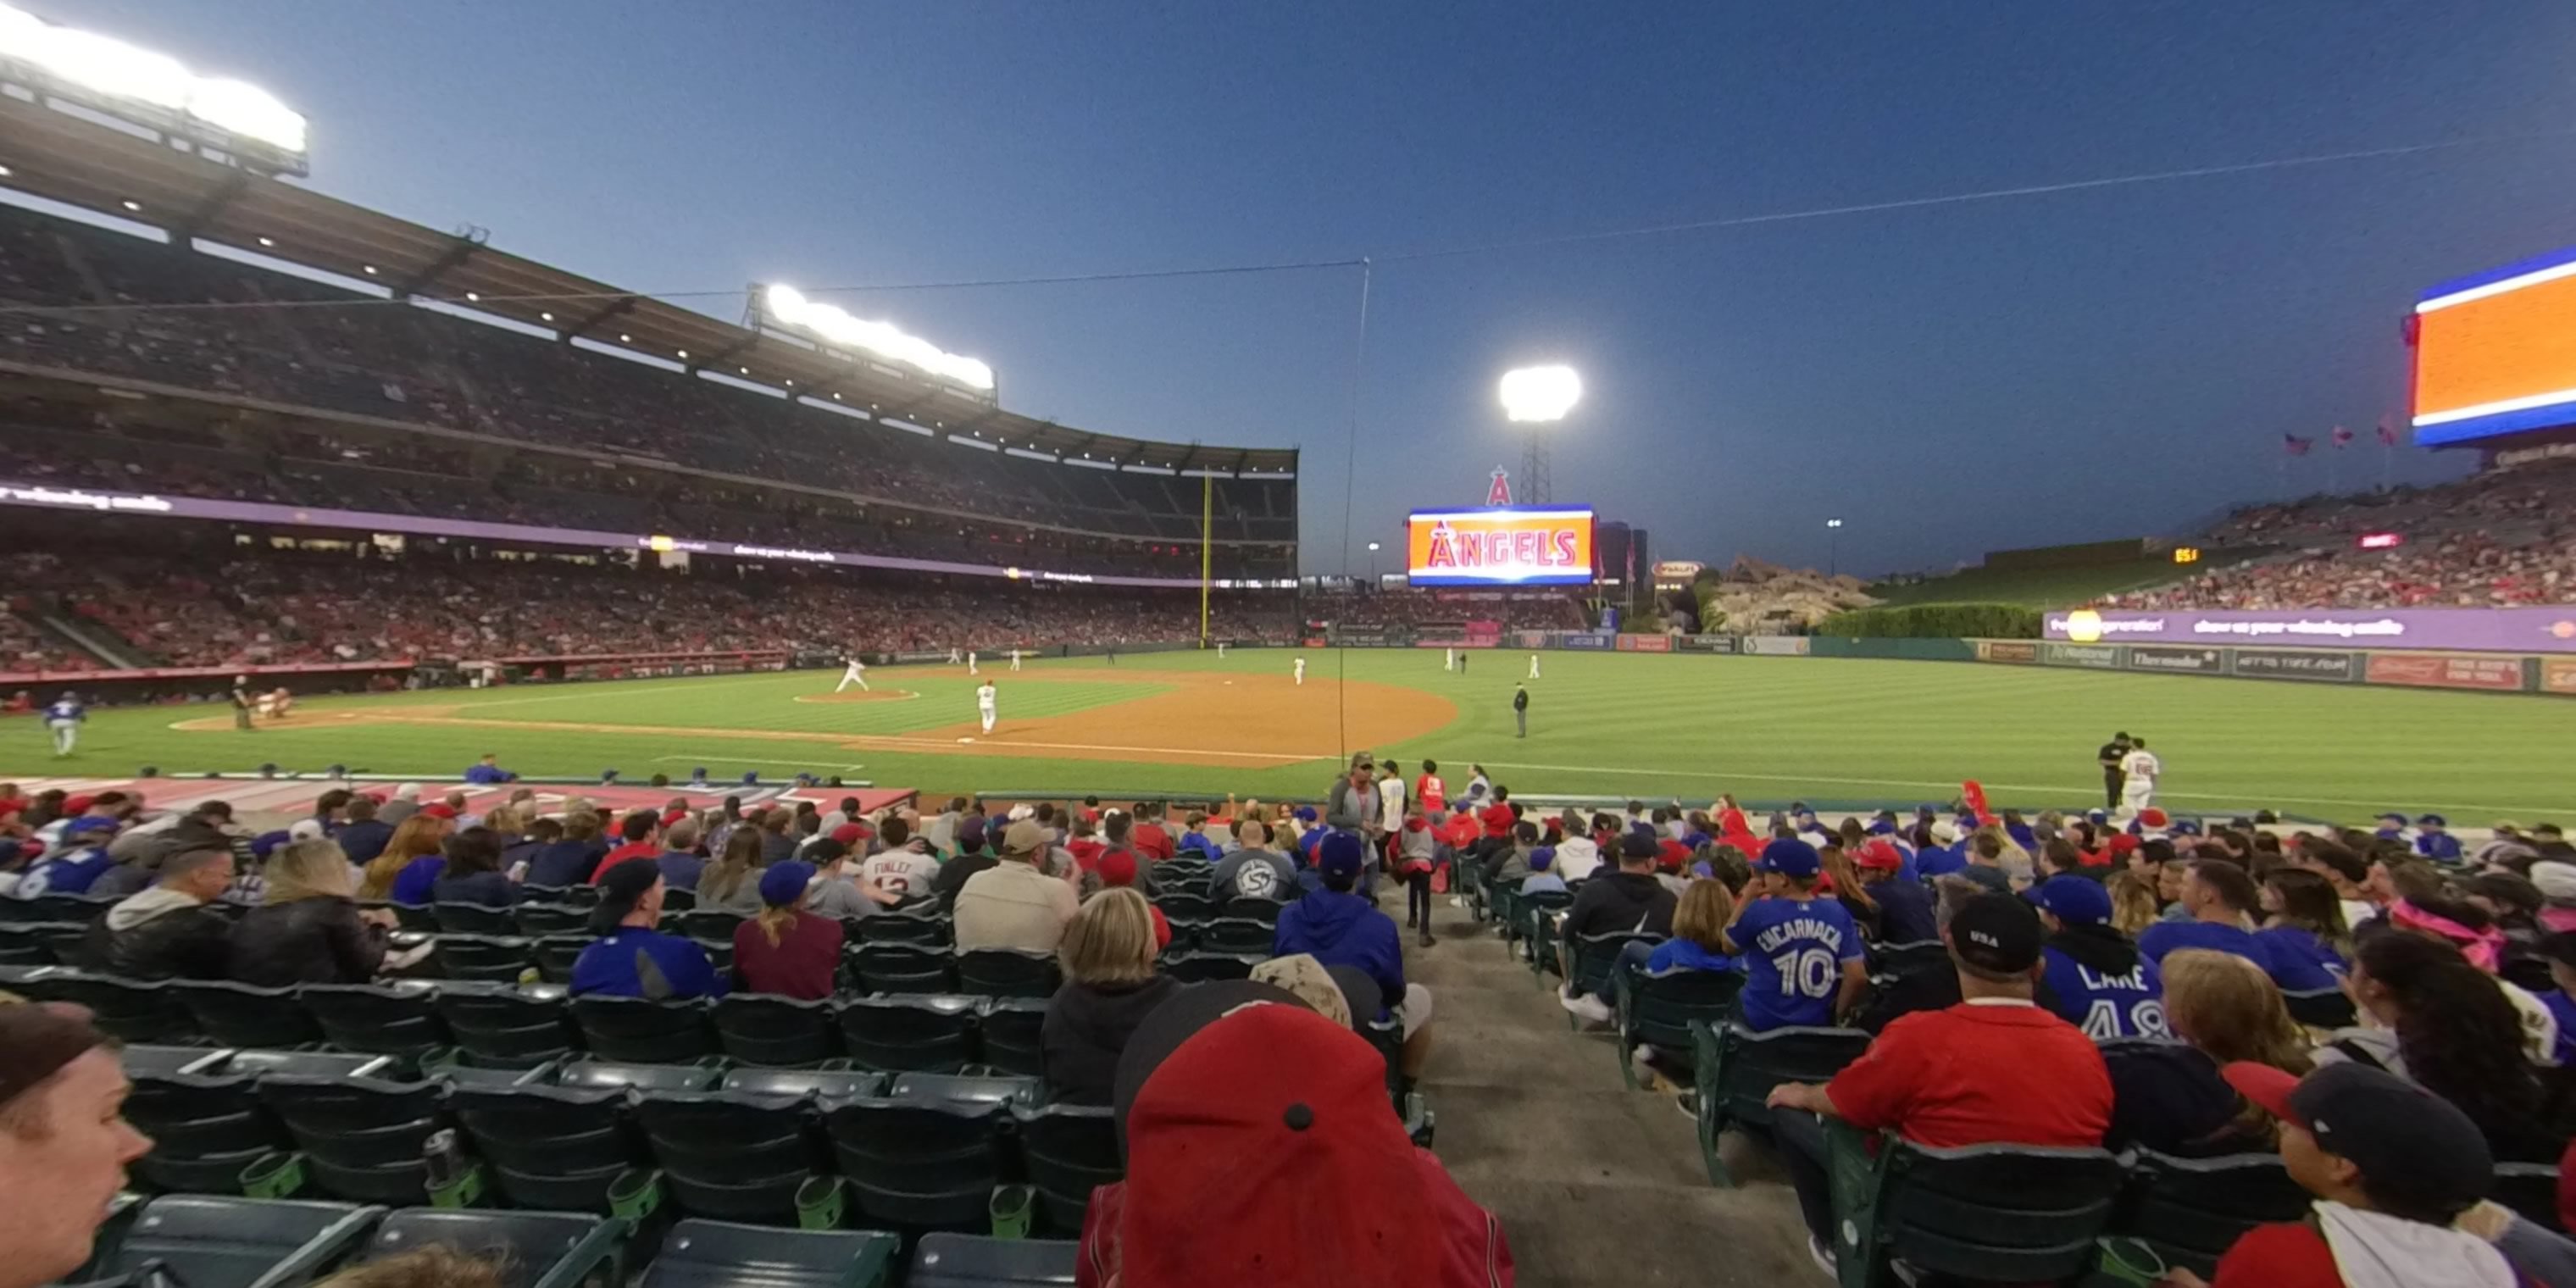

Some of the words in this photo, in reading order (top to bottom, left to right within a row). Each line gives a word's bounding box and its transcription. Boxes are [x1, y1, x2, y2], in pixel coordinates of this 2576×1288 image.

[1428, 519, 1576, 568] ANGELS
[874, 861, 912, 875] FINLEY
[1970, 930, 1999, 947] USA
[1772, 948, 1835, 999] 10
